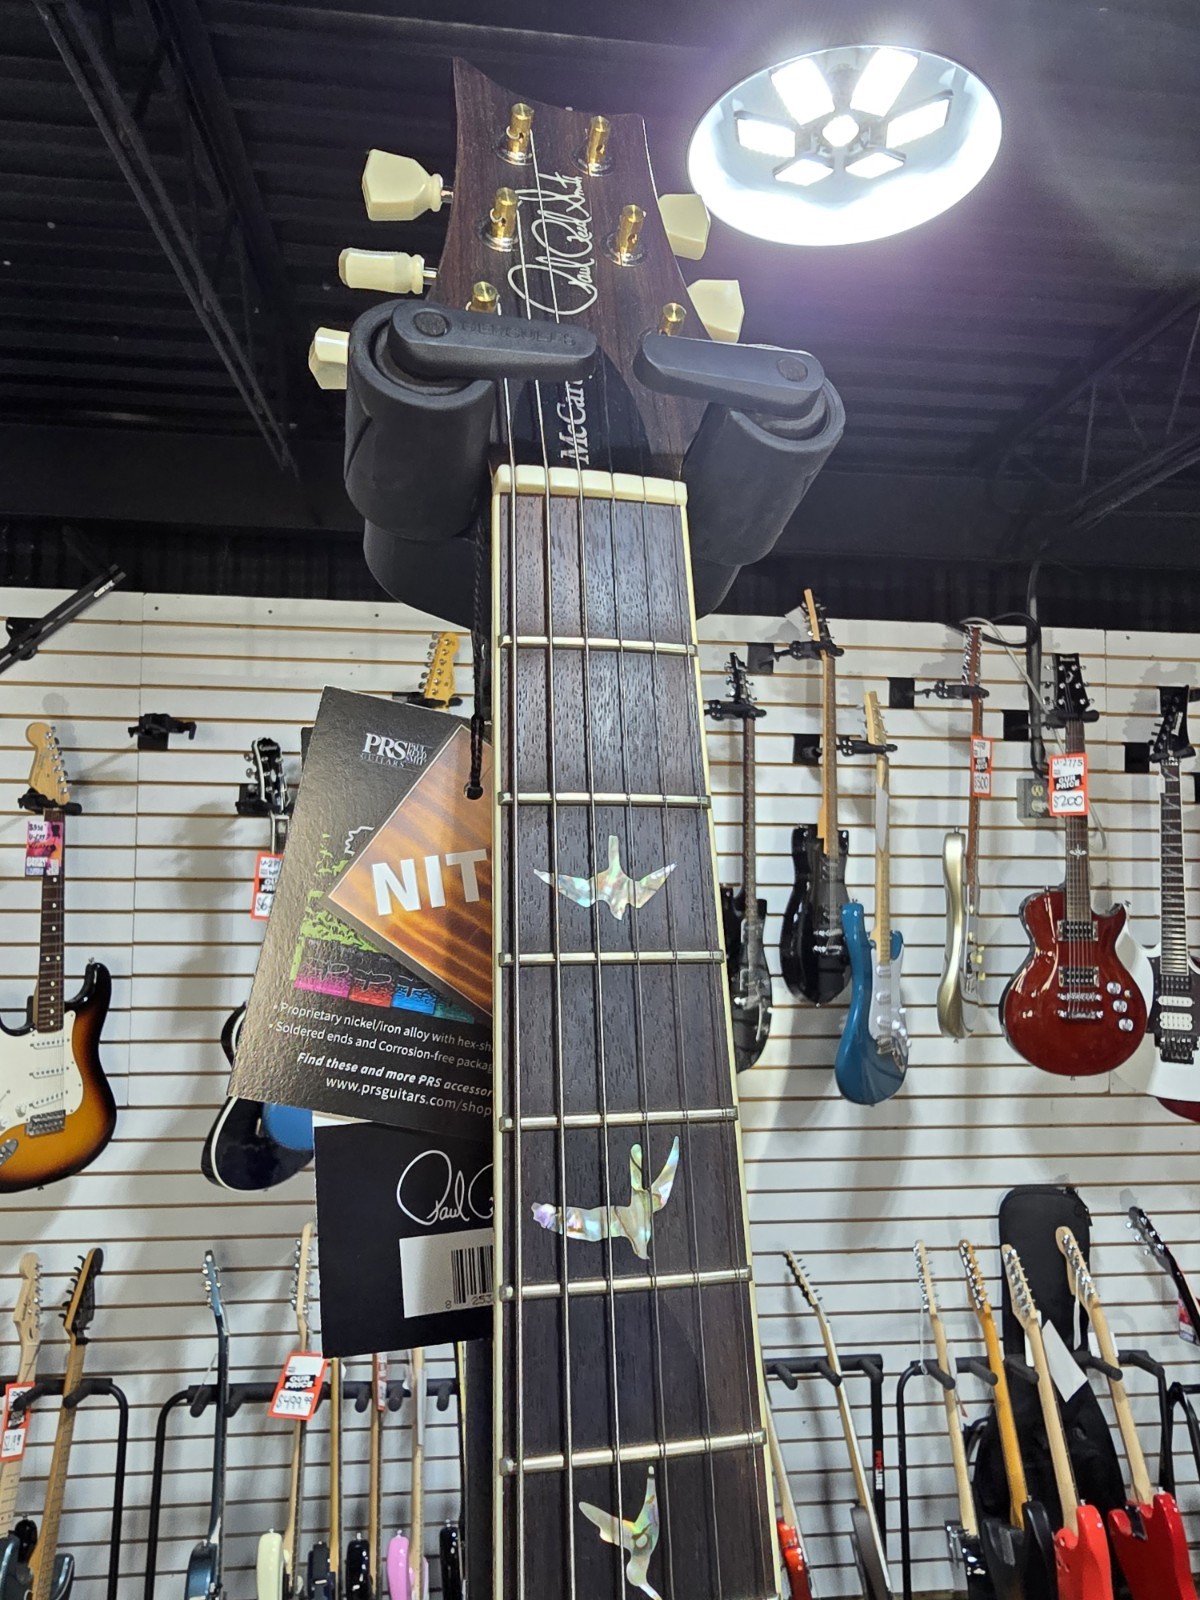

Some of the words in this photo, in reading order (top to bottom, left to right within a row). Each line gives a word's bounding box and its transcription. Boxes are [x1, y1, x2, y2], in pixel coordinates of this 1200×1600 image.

[362, 733, 408, 760] PRS
[1058, 775, 1076, 784] OUR
[1053, 795, 1083, 808] $200
[279, 1002, 342, 1028] Proprietary
[343, 1015, 401, 1034] nickel/iron
[403, 1026, 430, 1042] alloy
[432, 1032, 455, 1045] with
[275, 1021, 326, 1040] Soldered
[327, 1033, 353, 1045] ends
[355, 1038, 378, 1049] and
[378, 1040, 455, 1064] Corrosion-free
[297, 1052, 326, 1067] Find
[325, 1057, 359, 1073] these
[360, 1066, 385, 1078] and
[385, 1070, 416, 1084] more
[418, 1074, 443, 1088] PRS
[326, 1077, 492, 1118] www.prsguitars.com/shop
[396, 1149, 470, 1226] Paul
[444, 1299, 453, 1310] 8
